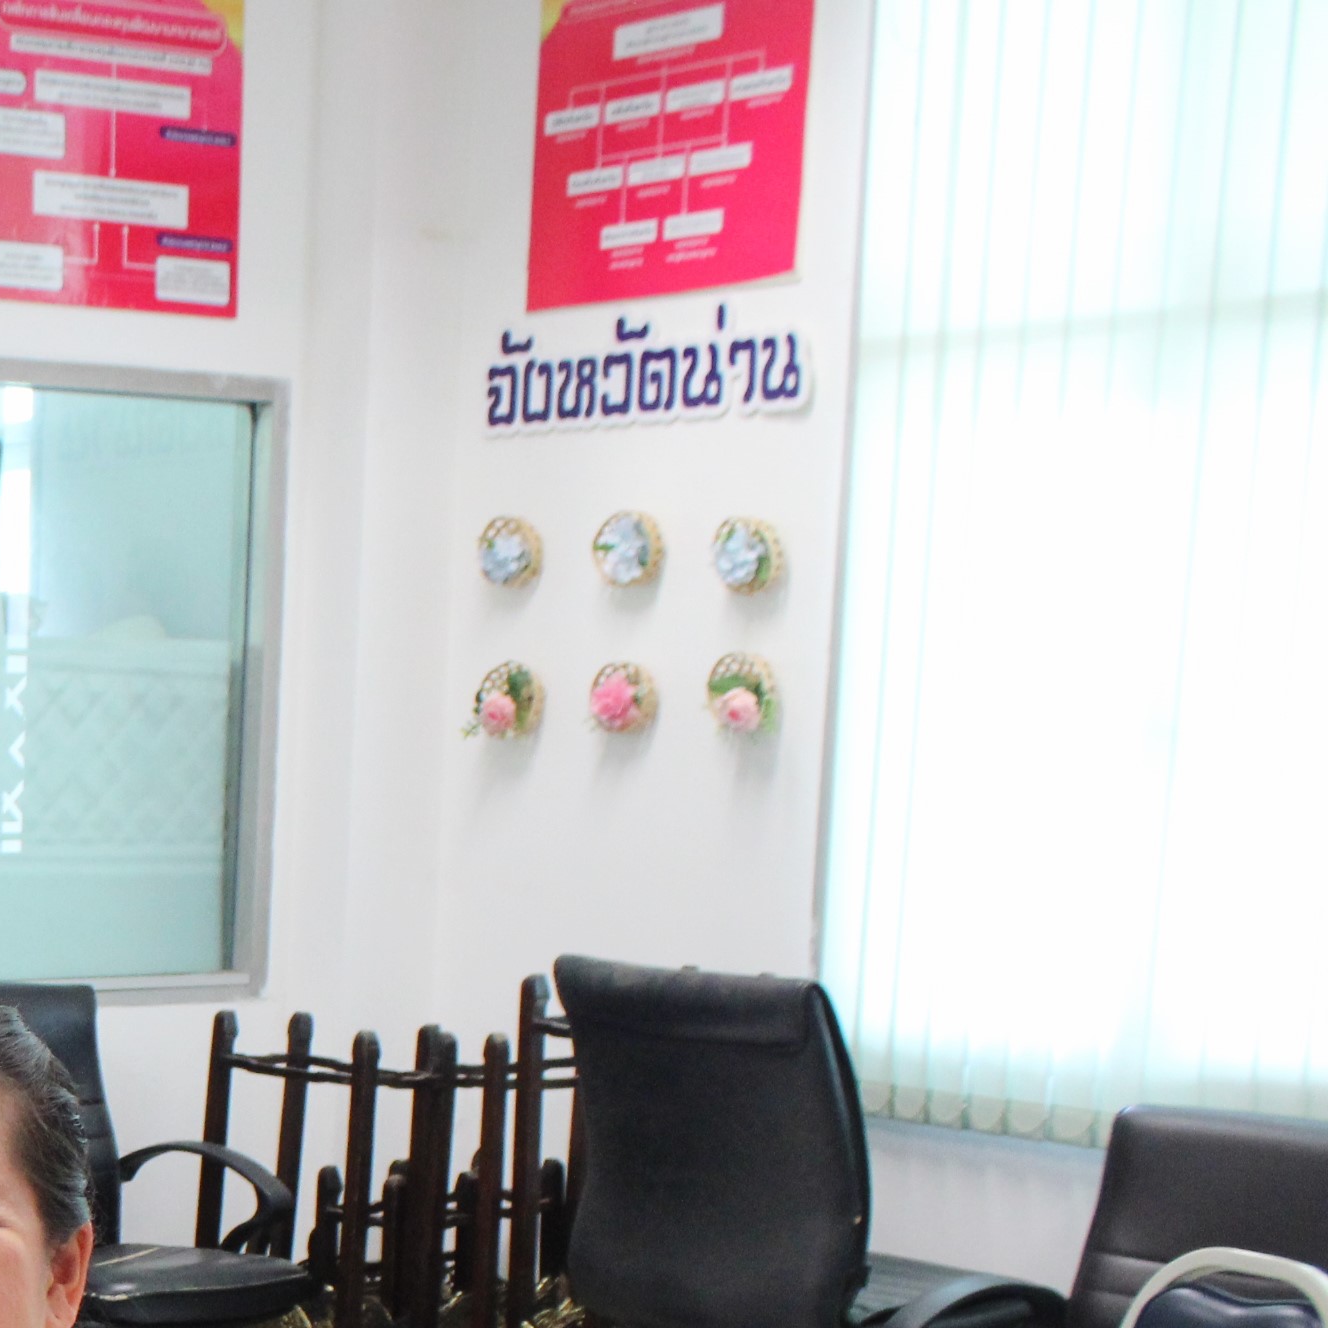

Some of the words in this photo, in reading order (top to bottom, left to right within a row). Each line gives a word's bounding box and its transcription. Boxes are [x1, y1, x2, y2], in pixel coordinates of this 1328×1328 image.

[487, 303, 802, 427] จังหวัดน่าน
